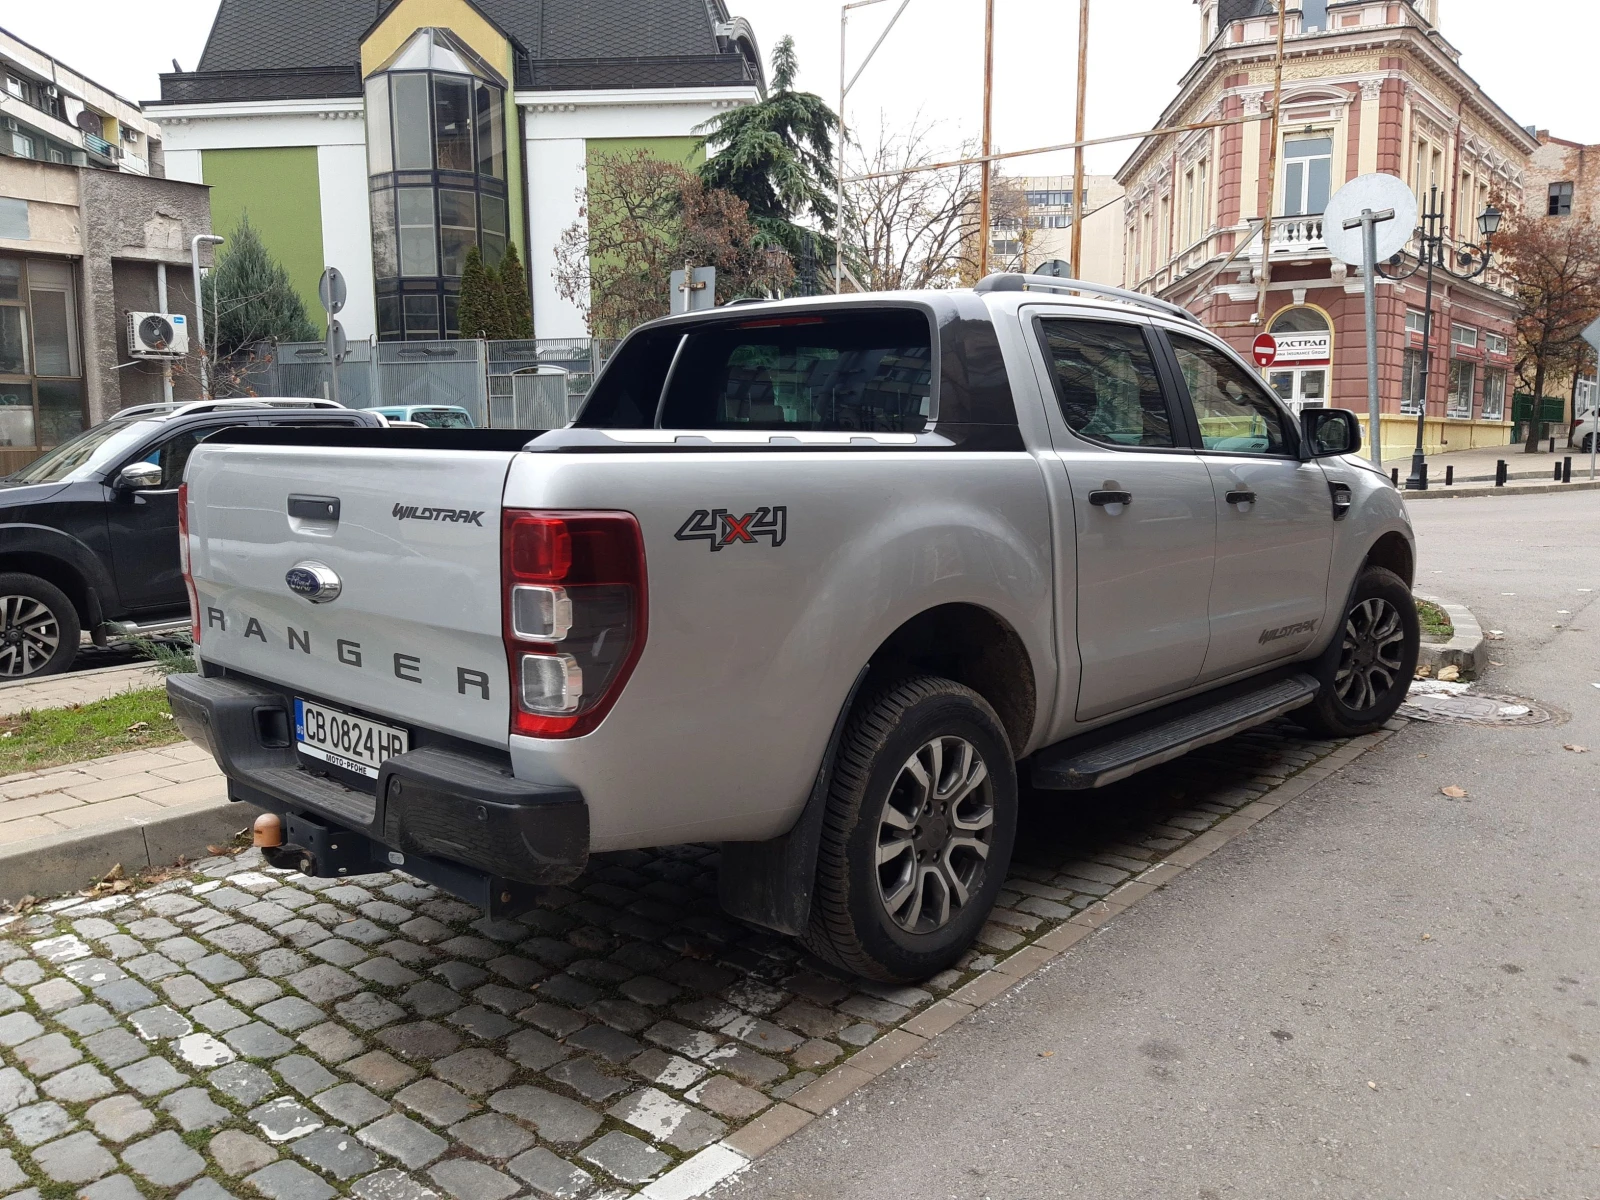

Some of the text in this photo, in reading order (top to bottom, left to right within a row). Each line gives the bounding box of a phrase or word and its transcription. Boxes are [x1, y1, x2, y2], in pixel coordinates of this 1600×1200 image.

[392, 502, 485, 527] WILDTRAK
[287, 571, 312, 591] Ford
[1258, 617, 1319, 646] WILDTRAK
[207, 606, 490, 700] RANGER
[305, 708, 327, 744] CB
[330, 716, 375, 761] 0824
[325, 754, 367, 775] MOTO-PFOHE
